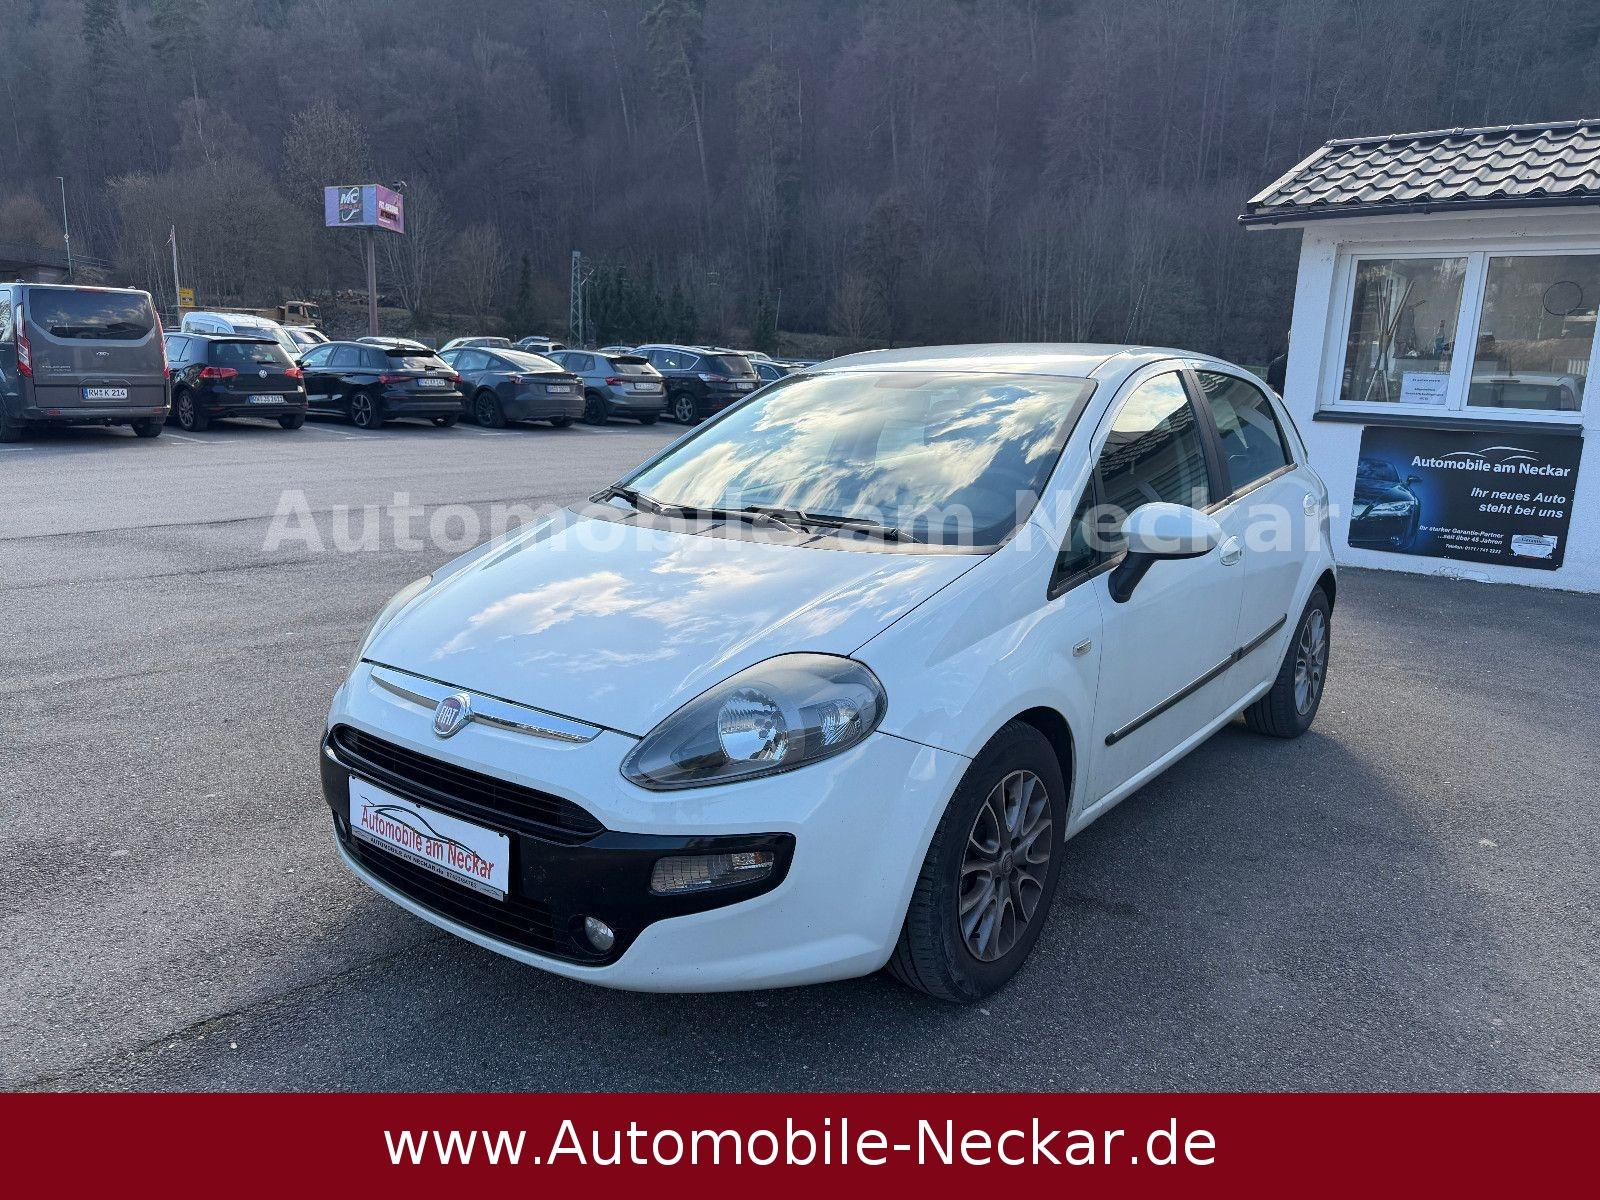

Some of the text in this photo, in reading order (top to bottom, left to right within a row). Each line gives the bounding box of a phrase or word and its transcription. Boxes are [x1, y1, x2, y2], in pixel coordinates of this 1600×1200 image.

[1411, 455, 1571, 477] Automobile am Neckar
[1470, 487, 1567, 504] Ihr neues Auto
[1478, 503, 1564, 519] steht bei uns
[1480, 537, 1503, 545] Jahren
[437, 705, 459, 726] FIAT
[361, 805, 495, 881] Automobile am Neckar
